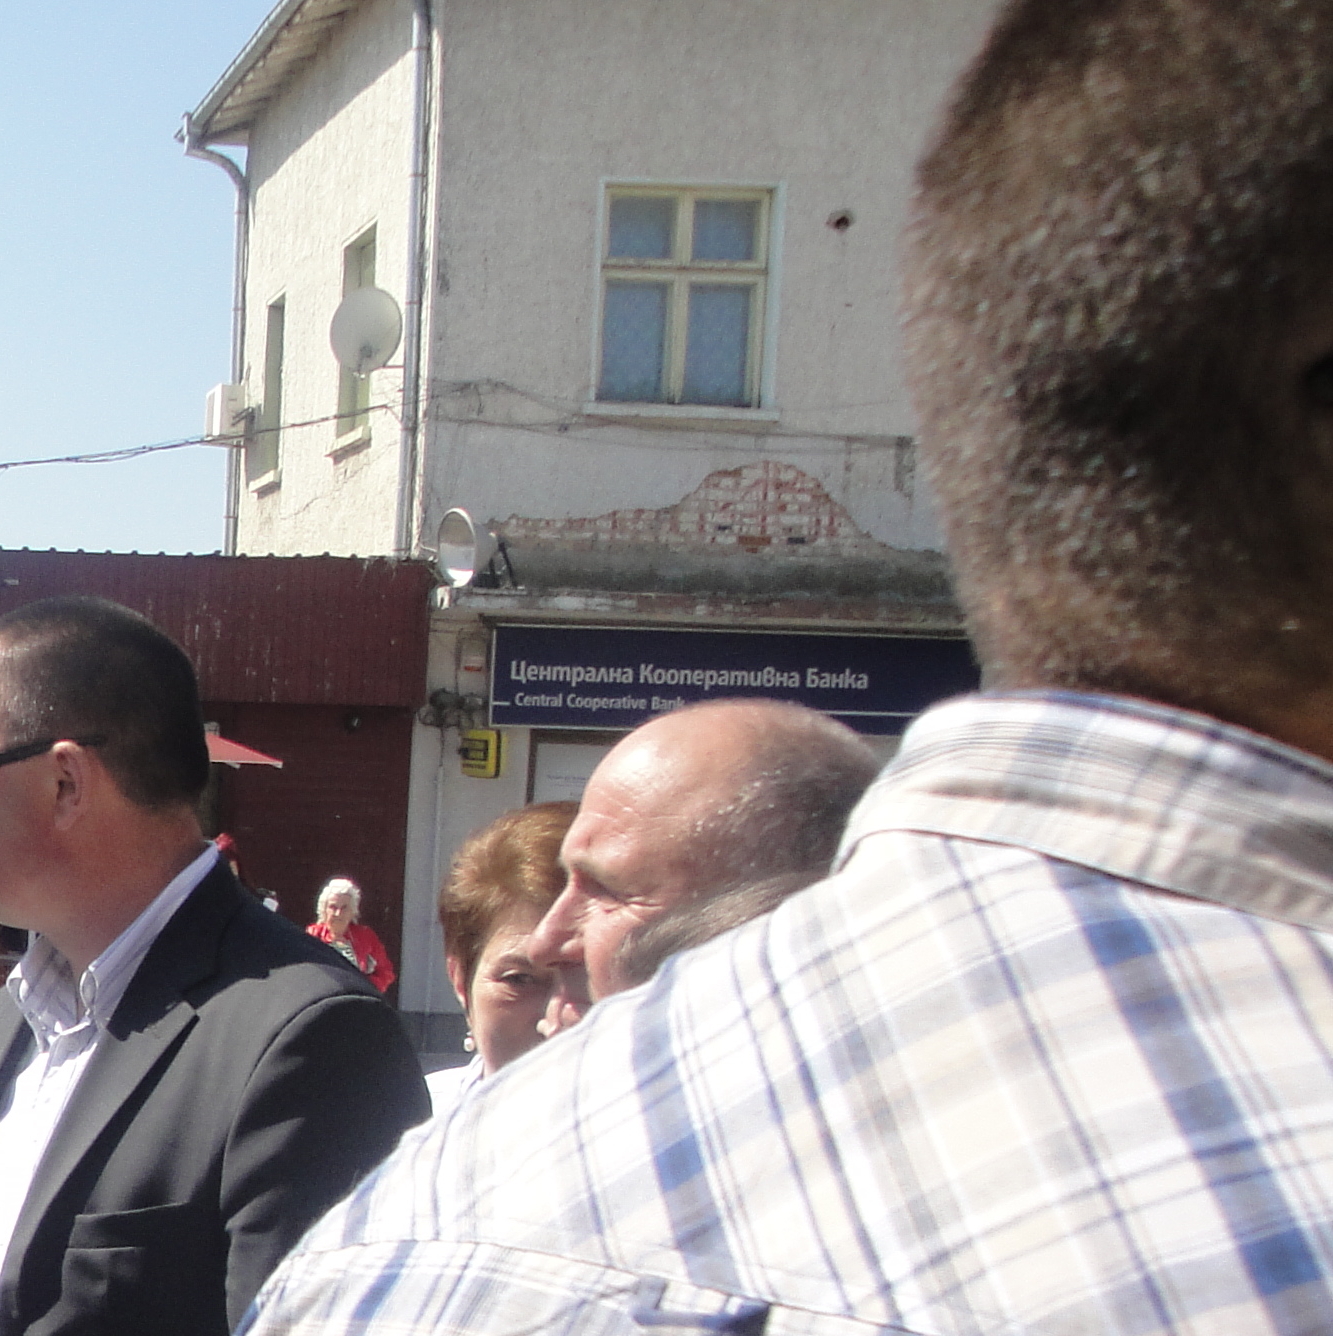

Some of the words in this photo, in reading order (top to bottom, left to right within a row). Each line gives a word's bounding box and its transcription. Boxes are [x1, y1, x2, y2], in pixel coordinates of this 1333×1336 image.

[510, 660, 633, 687] Централна
[639, 663, 800, 691] Кооперативна
[806, 667, 869, 689] Банка
[514, 692, 563, 708] Central
[566, 693, 648, 712] Cooperative
